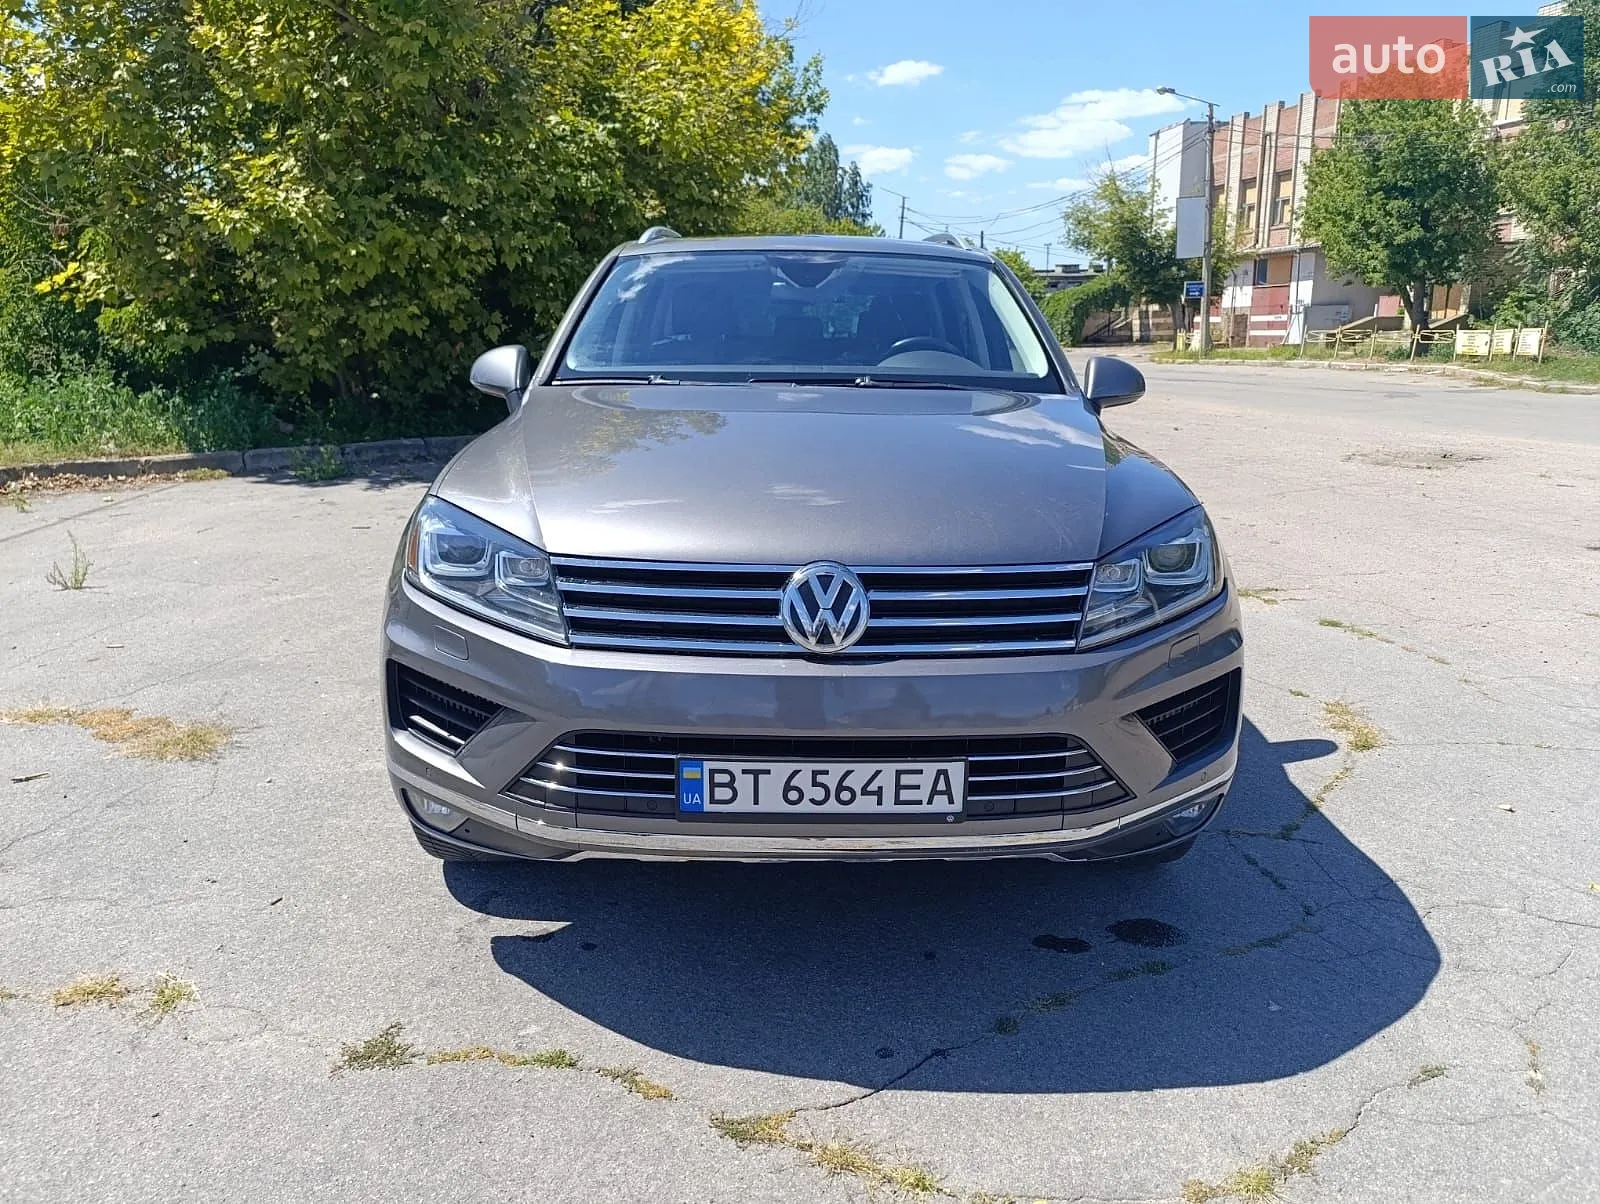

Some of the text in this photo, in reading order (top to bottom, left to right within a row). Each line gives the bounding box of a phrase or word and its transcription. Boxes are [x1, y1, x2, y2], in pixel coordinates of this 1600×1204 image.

[683, 793, 702, 805] UA
[708, 768, 955, 806] BT 6564 EA
